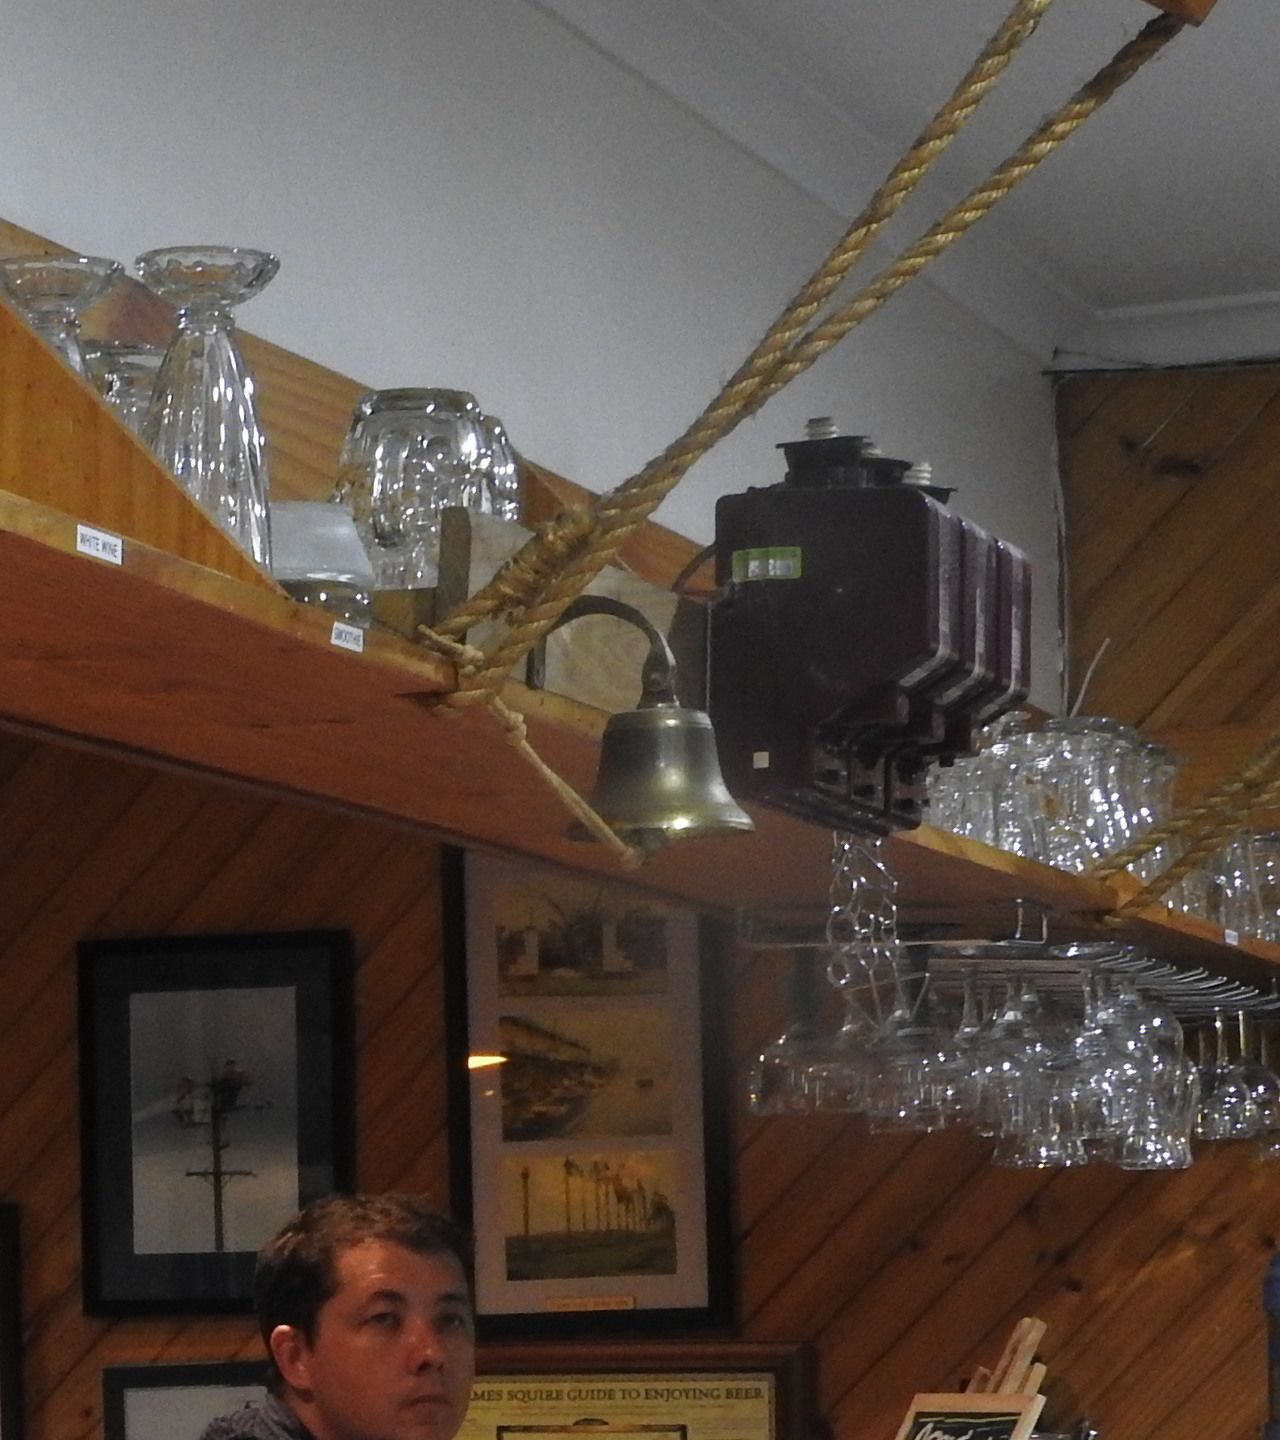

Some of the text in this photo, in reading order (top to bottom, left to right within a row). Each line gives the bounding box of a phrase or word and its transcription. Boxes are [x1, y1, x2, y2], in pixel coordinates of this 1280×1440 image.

[80, 532, 119, 559] WHITE WINE
[470, 1386, 765, 1403] MES SQUIRE GUIDE TO ENJOYING BEER
